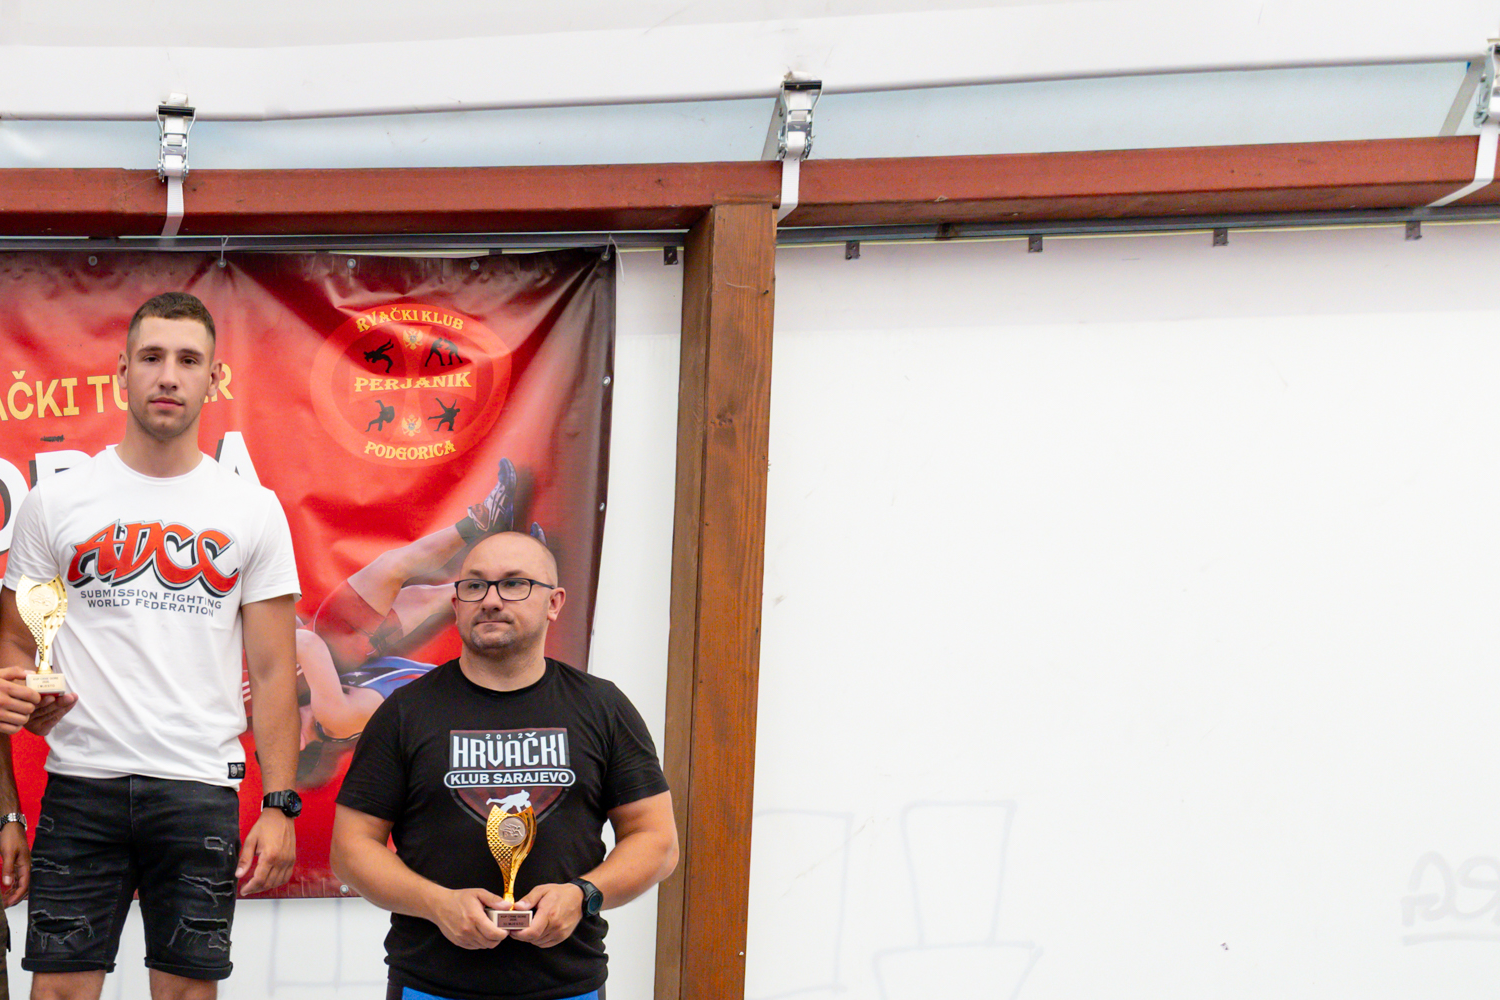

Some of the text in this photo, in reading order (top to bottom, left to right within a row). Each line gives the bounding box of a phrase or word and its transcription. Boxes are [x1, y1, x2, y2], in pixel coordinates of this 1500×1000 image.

[356, 307, 464, 332] RVAČKI KLUB
[354, 372, 472, 392] PERJANIK
[364, 440, 456, 460] PODGORICA
[80, 588, 222, 609] SUBMISSION FIGHTING
[87, 598, 214, 617] WORLD FEDERATION
[452, 731, 566, 769] HRVAČKI
[450, 771, 570, 785] KLUB SARAJEVO
